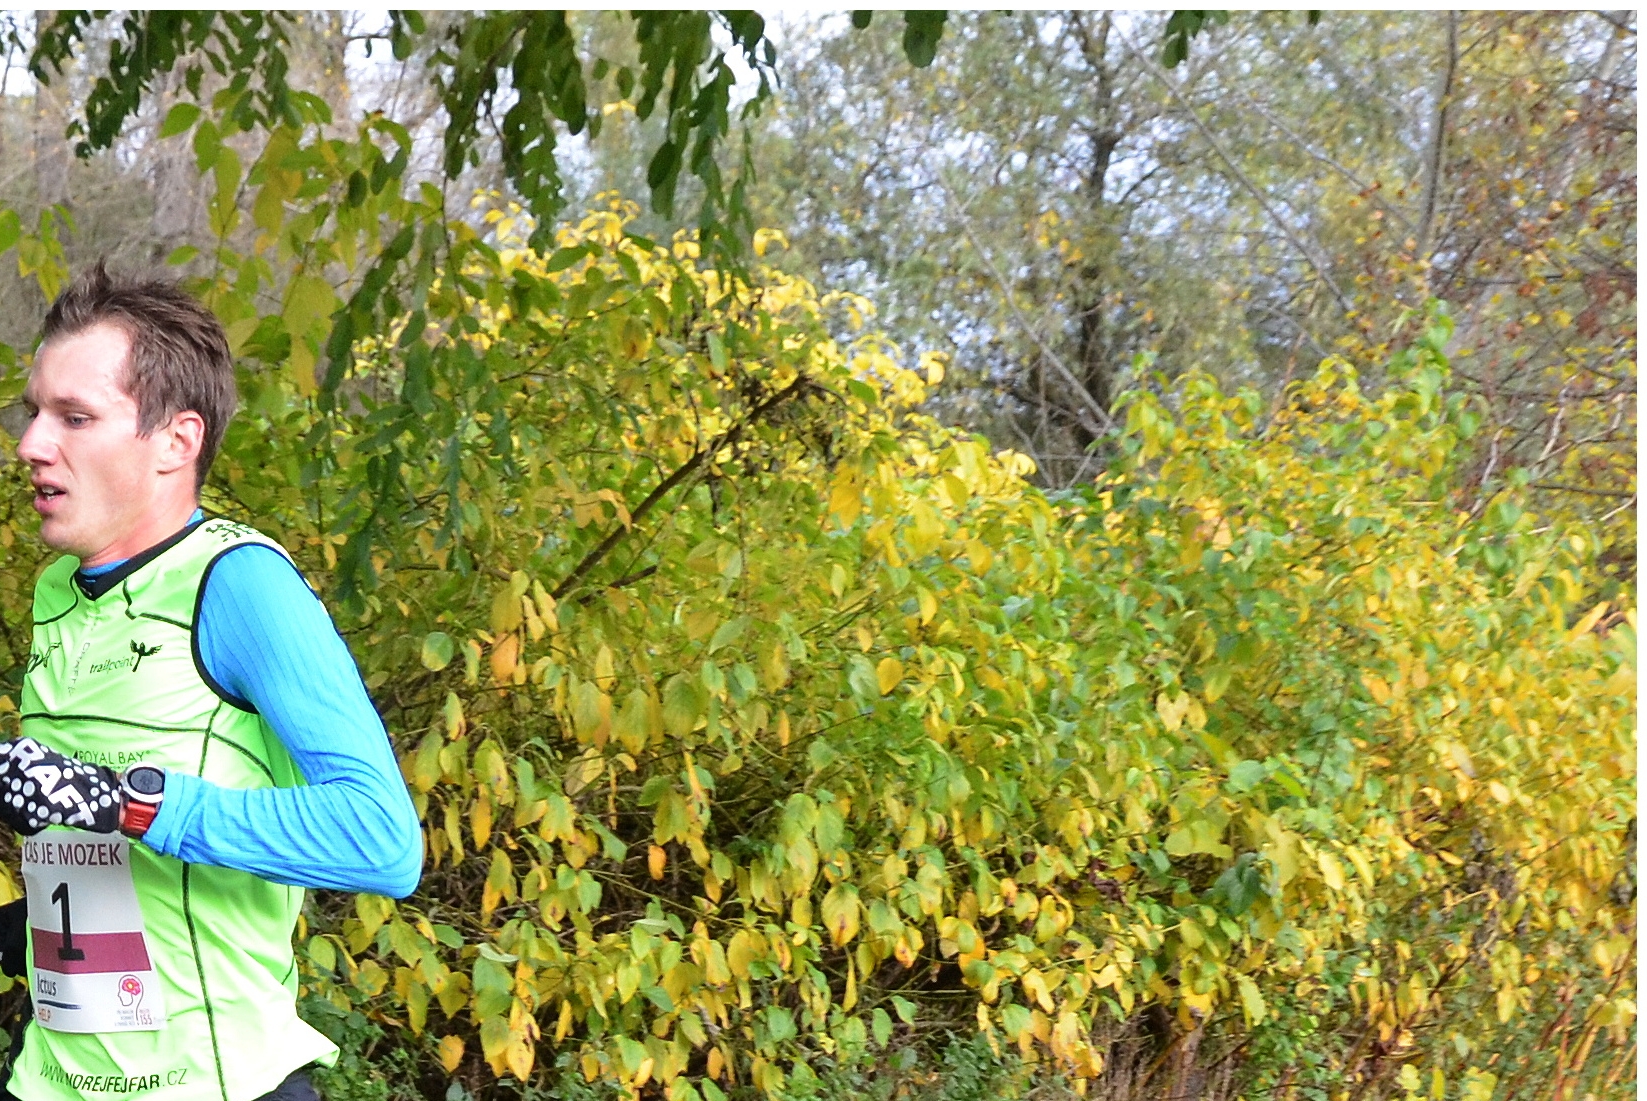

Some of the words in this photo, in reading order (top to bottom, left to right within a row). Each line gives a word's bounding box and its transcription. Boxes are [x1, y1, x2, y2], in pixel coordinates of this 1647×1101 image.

[118, 751, 144, 764] BAY
[41, 842, 54, 865] JE
[58, 843, 122, 865] MOZEK
[52, 882, 85, 960] 1
